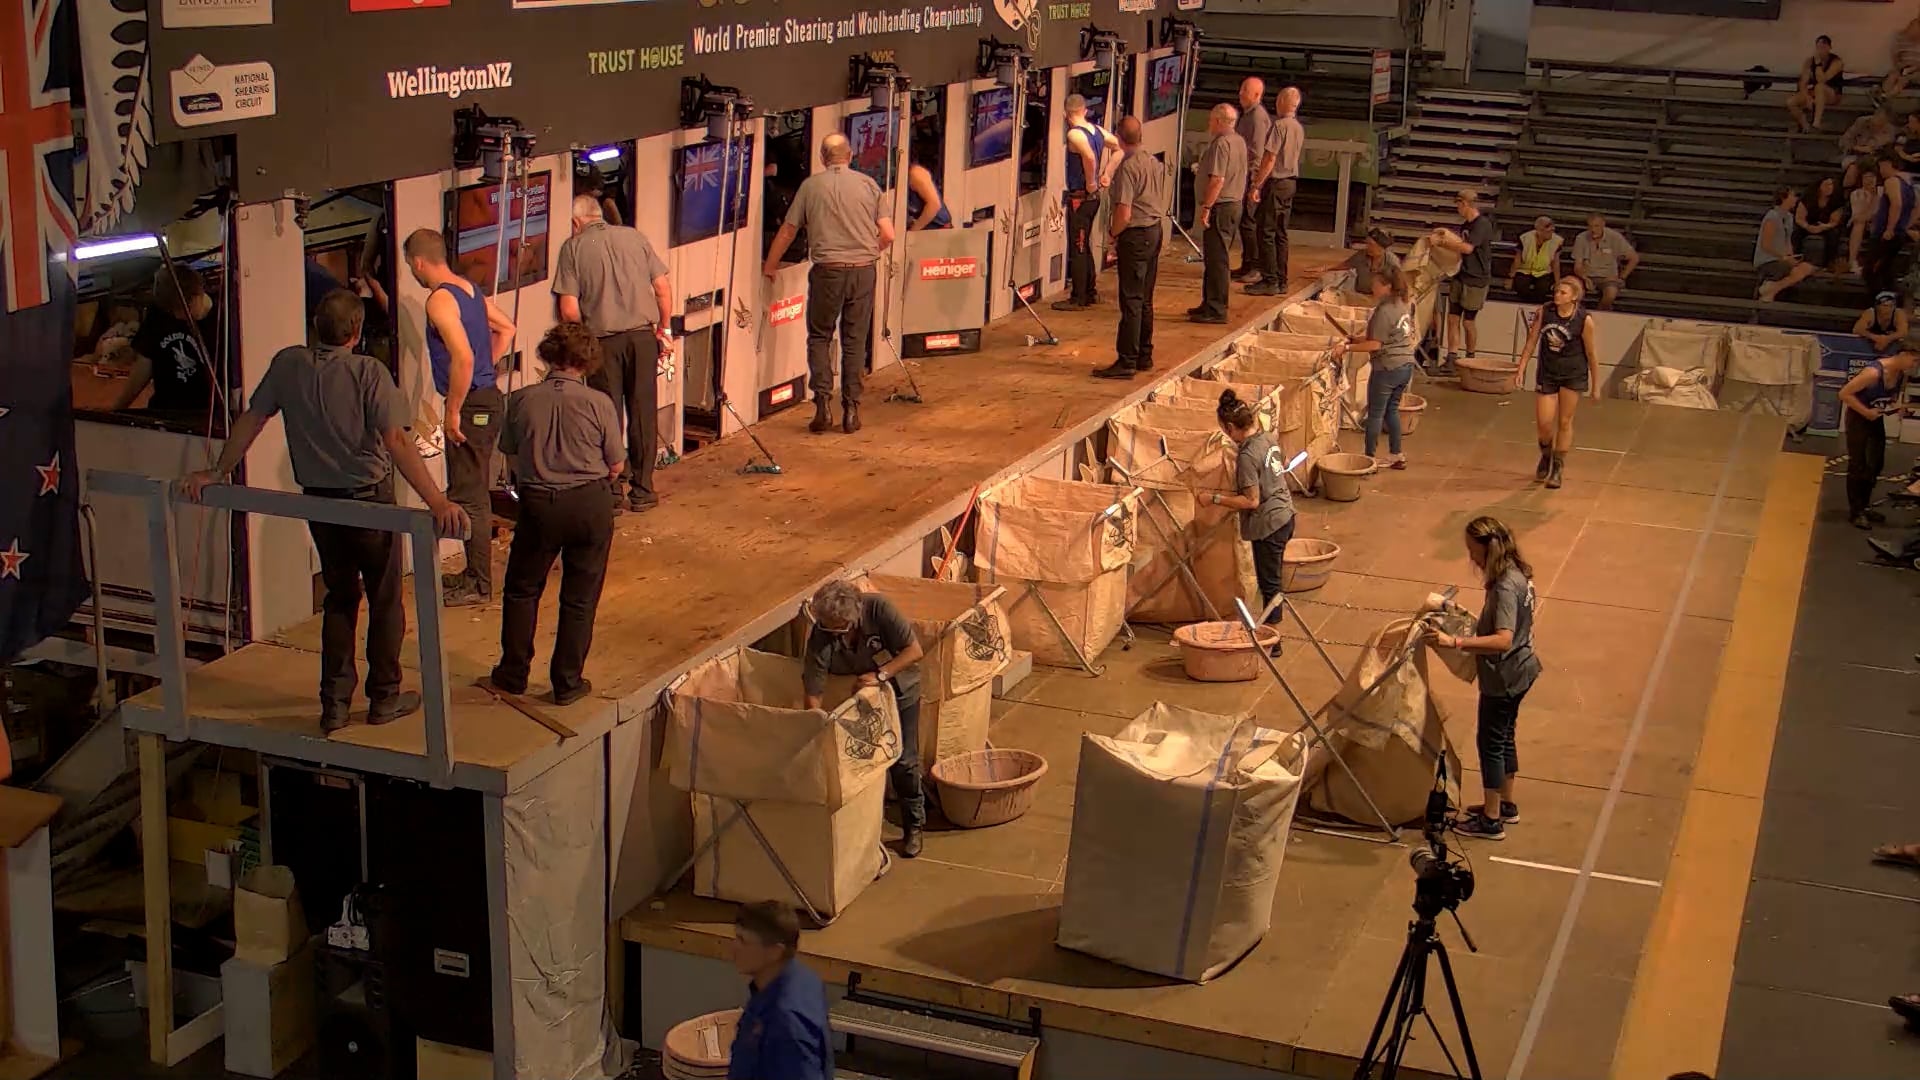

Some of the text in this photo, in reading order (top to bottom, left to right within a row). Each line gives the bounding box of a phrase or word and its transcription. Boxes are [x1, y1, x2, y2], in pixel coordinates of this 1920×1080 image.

[1049, 2, 1090, 20] TRUST HOUSE
[693, 3, 983, 54] World Premier Shearing and Woolhandling Championship
[588, 45, 684, 74] TRUST HOUSE
[234, 72, 269, 84] NATIONAL
[388, 62, 512, 98] WellingtonNZ
[235, 84, 269, 96] SHEARING
[235, 97, 262, 109] CIRCUIT
[921, 264, 975, 278] Heiniger
[770, 302, 803, 324] Heiniger
